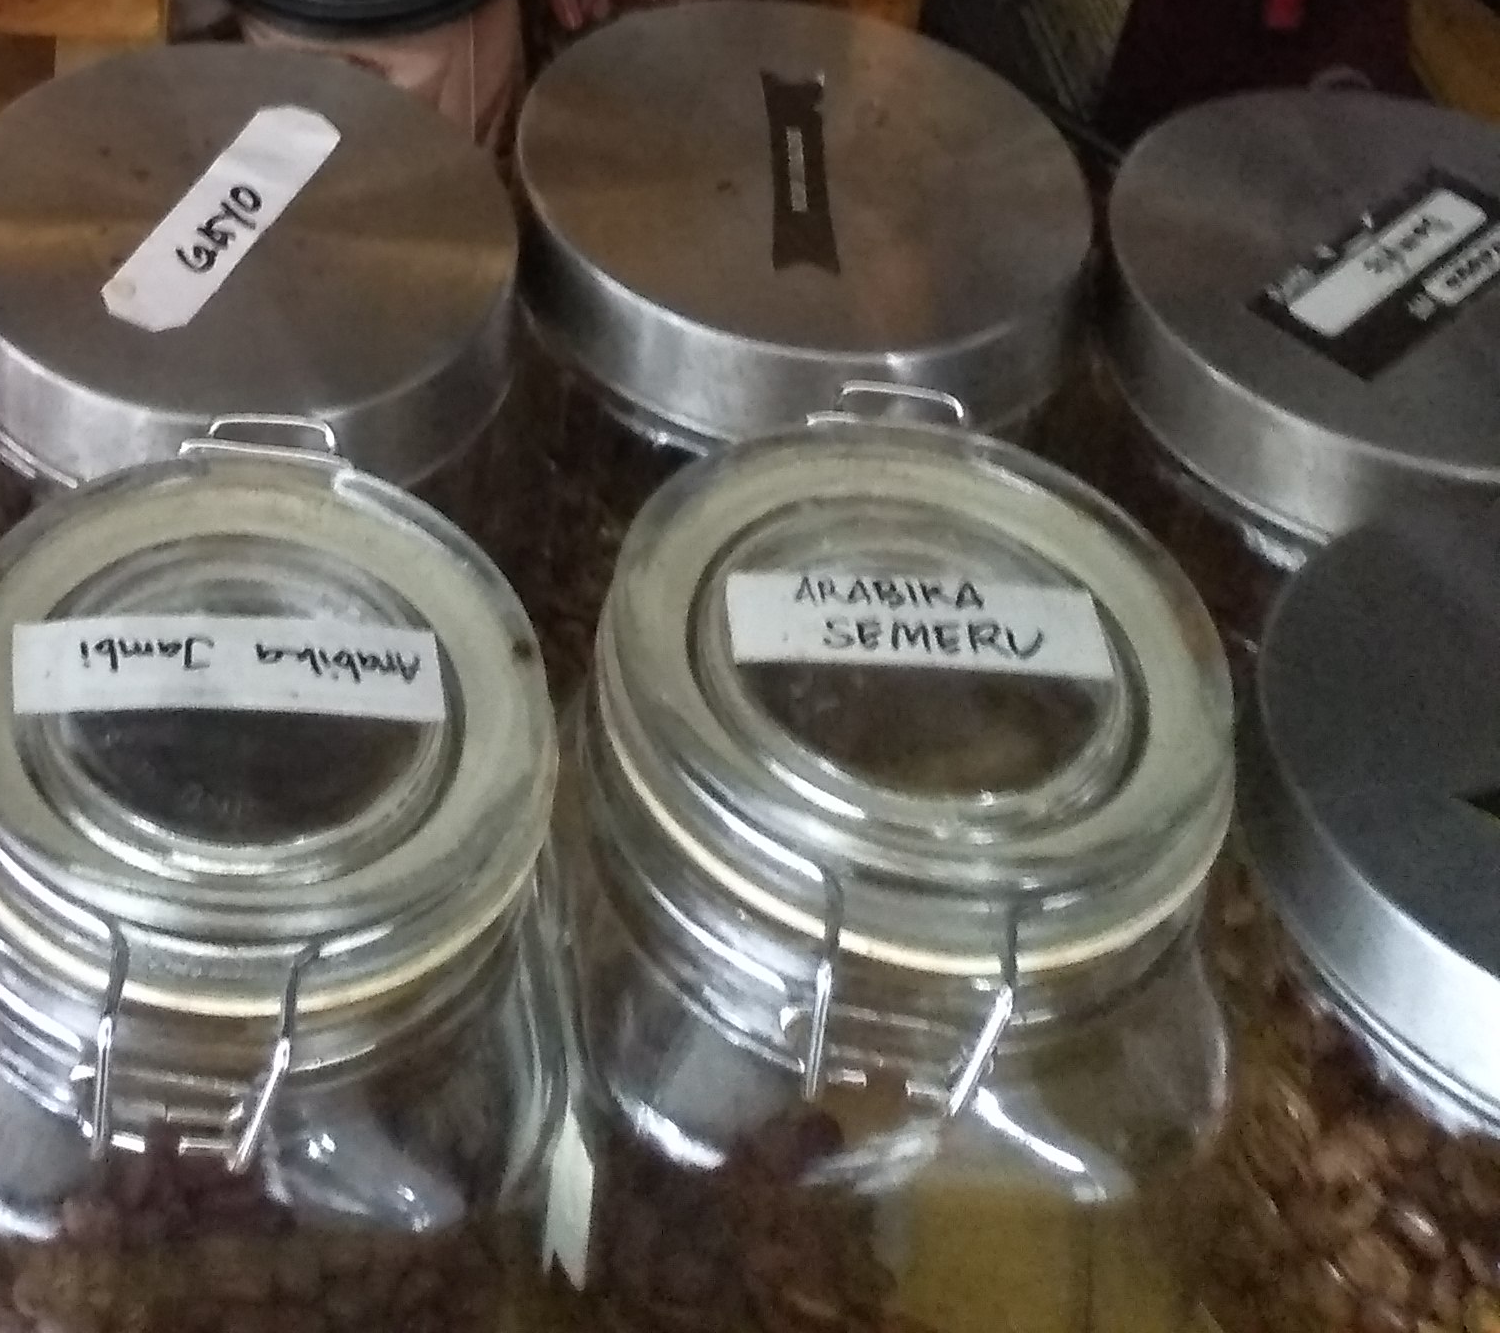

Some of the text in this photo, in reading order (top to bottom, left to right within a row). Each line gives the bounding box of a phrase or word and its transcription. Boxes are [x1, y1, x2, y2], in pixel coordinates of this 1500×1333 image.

[793, 576, 984, 611] ARABIKA
[79, 634, 421, 684] Arabika Jambi
[822, 616, 1044, 660] SEMERU
